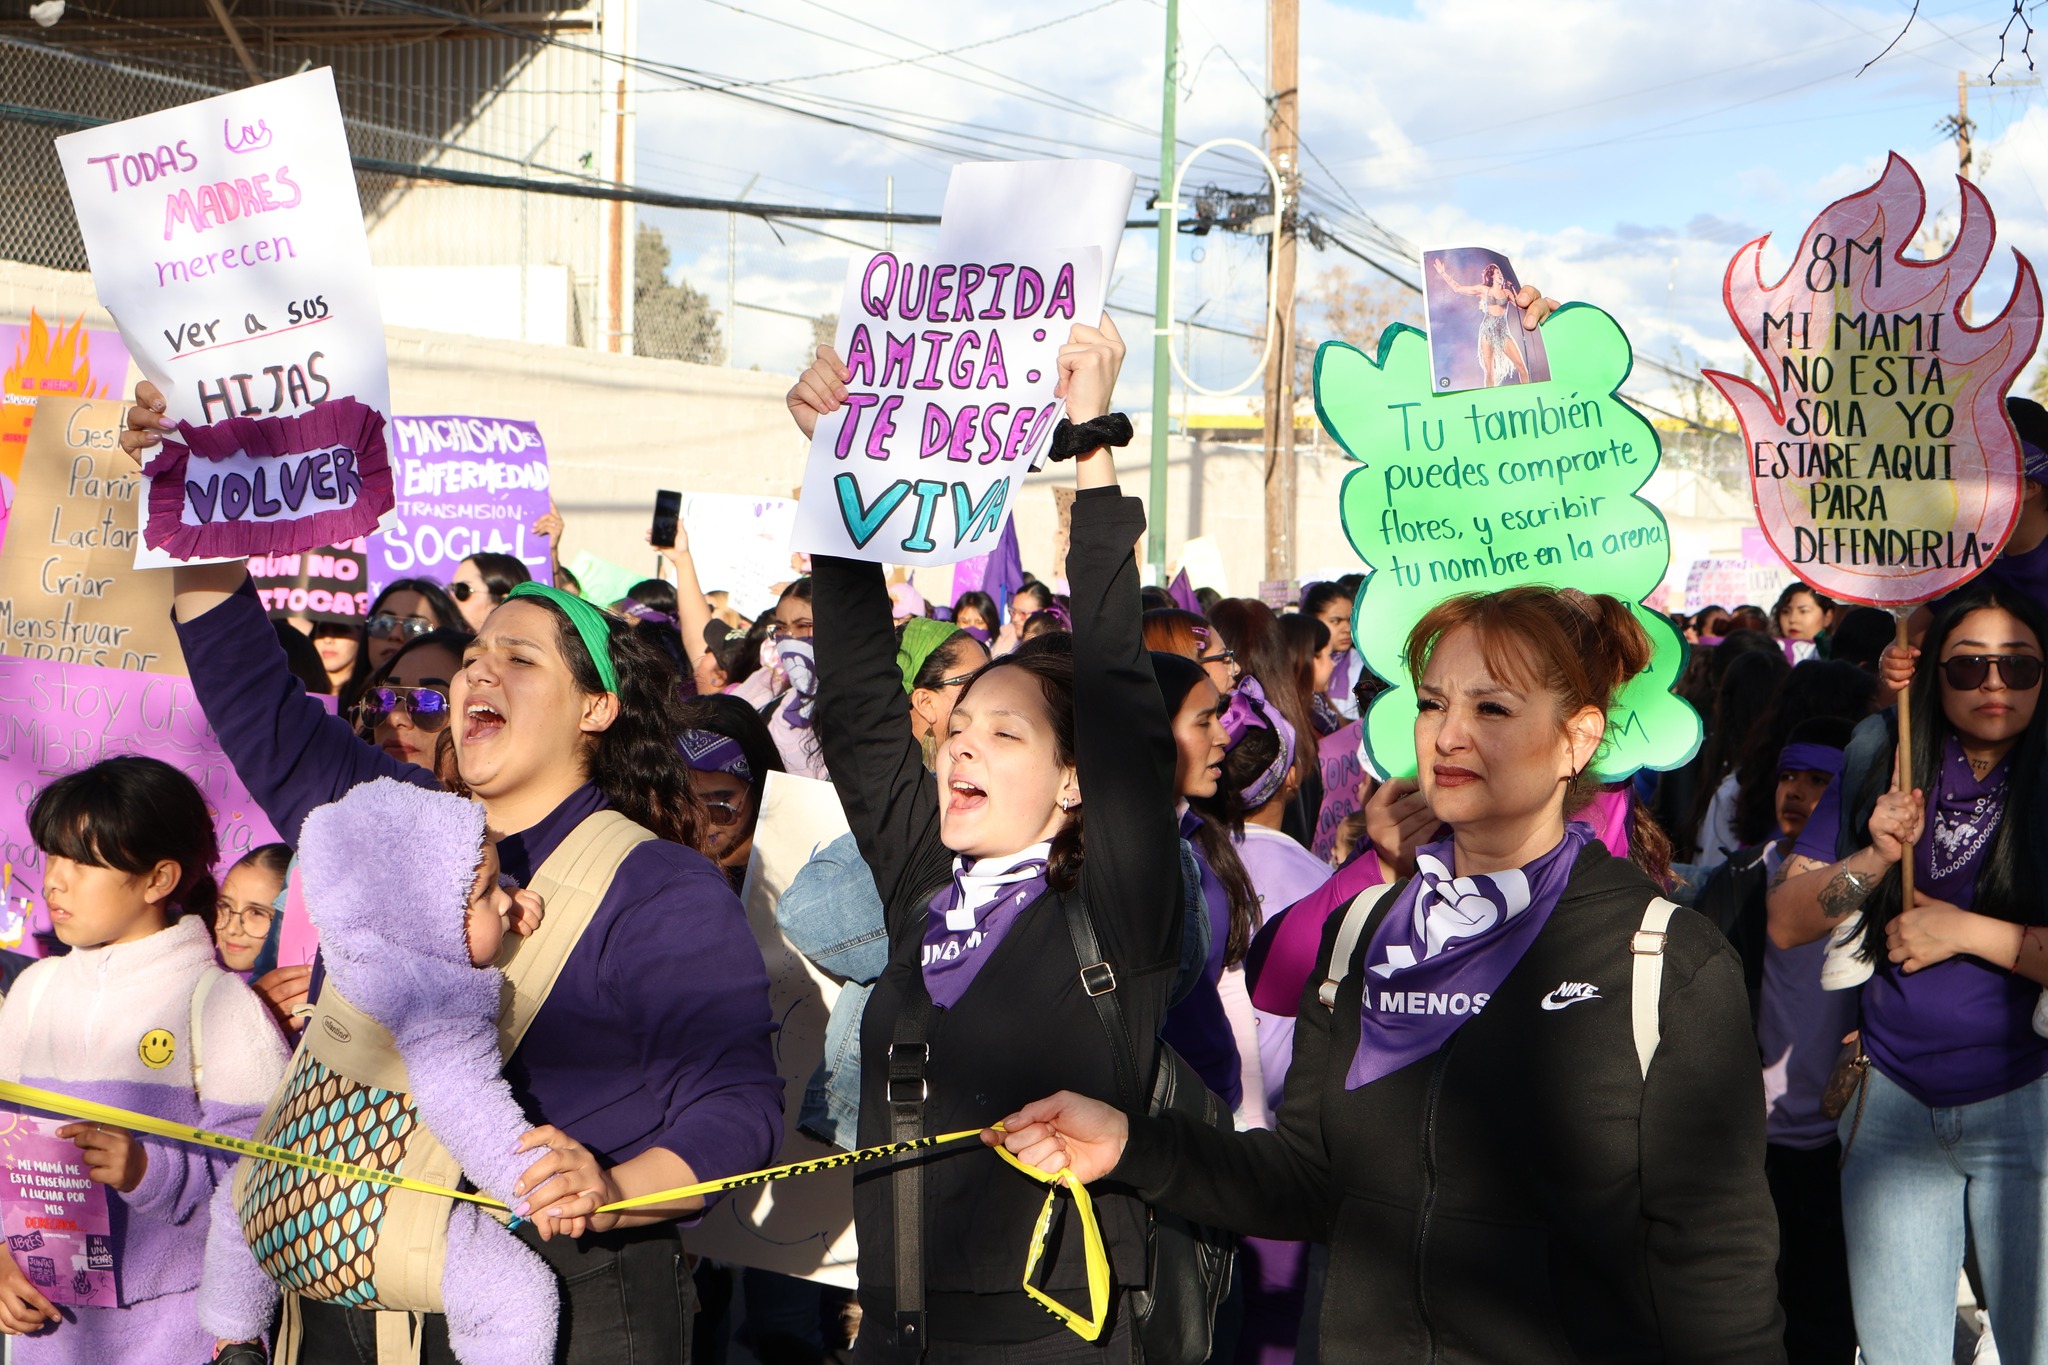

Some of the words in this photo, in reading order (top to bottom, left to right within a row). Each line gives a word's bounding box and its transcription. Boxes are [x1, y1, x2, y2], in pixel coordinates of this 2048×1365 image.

[88, 140, 198, 192] TODAS
[163, 166, 301, 240] MADRES
[155, 235, 296, 287] merecen
[1805, 232, 1882, 293] 8M
[860, 252, 1075, 322] QUERIDA
[164, 316, 220, 354] ver
[245, 312, 265, 334] a
[1762, 311, 1813, 351] MI
[1834, 312, 1946, 352] MAMI
[198, 351, 331, 424] HIJAS
[1782, 355, 1834, 394] NO
[1849, 355, 1945, 397] ESTA
[394, 418, 526, 455] MACHISMO
[834, 393, 904, 461] TE
[920, 401, 1057, 465] DESEO
[1387, 402, 1445, 451] Tu
[1464, 391, 1603, 444] también
[1786, 400, 1867, 438] SOLA
[1895, 401, 1954, 438] YO
[69, 455, 140, 499] Parir
[404, 458, 549, 496] ENFERMEDAD
[1384, 456, 1490, 507] puedes
[1498, 439, 1638, 485] comprarte
[1755, 441, 1863, 480] ESTARE
[1866, 444, 1957, 482] AQUI
[186, 448, 363, 524] VOLVER
[1810, 483, 1887, 521] PARA
[51, 506, 138, 549] Lactar
[834, 472, 1011, 552] VIVA
[1379, 509, 1463, 546] flores,
[1473, 516, 1493, 545] y
[1501, 495, 1607, 532] escribir
[383, 519, 546, 570] SOCIAL
[1390, 555, 1422, 587] tu
[1429, 546, 1530, 583] nombre
[1534, 545, 1562, 567] en
[1567, 533, 1594, 561] la
[1792, 526, 1983, 569] DEFENDERLA
[41, 557, 114, 597] Criar
[307, 554, 359, 580] NO
[0, 600, 130, 646] Menstruar
[1380, 991, 1491, 1016] MENOS
[1553, 981, 1599, 997] NIKE
[17, 1158, 32, 1171] MI
[33, 1160, 64, 1175] MAMÁ
[65, 1164, 81, 1176] ME
[35, 1174, 92, 1190] ENSEÑANDO
[20, 1187, 28, 1199] A
[29, 1187, 66, 1202] LUCHAR
[66, 1191, 87, 1203] POR
[44, 1203, 65, 1216] MIS
[9, 1234, 44, 1251] LIBRES
[91, 1246, 109, 1255] UNA
